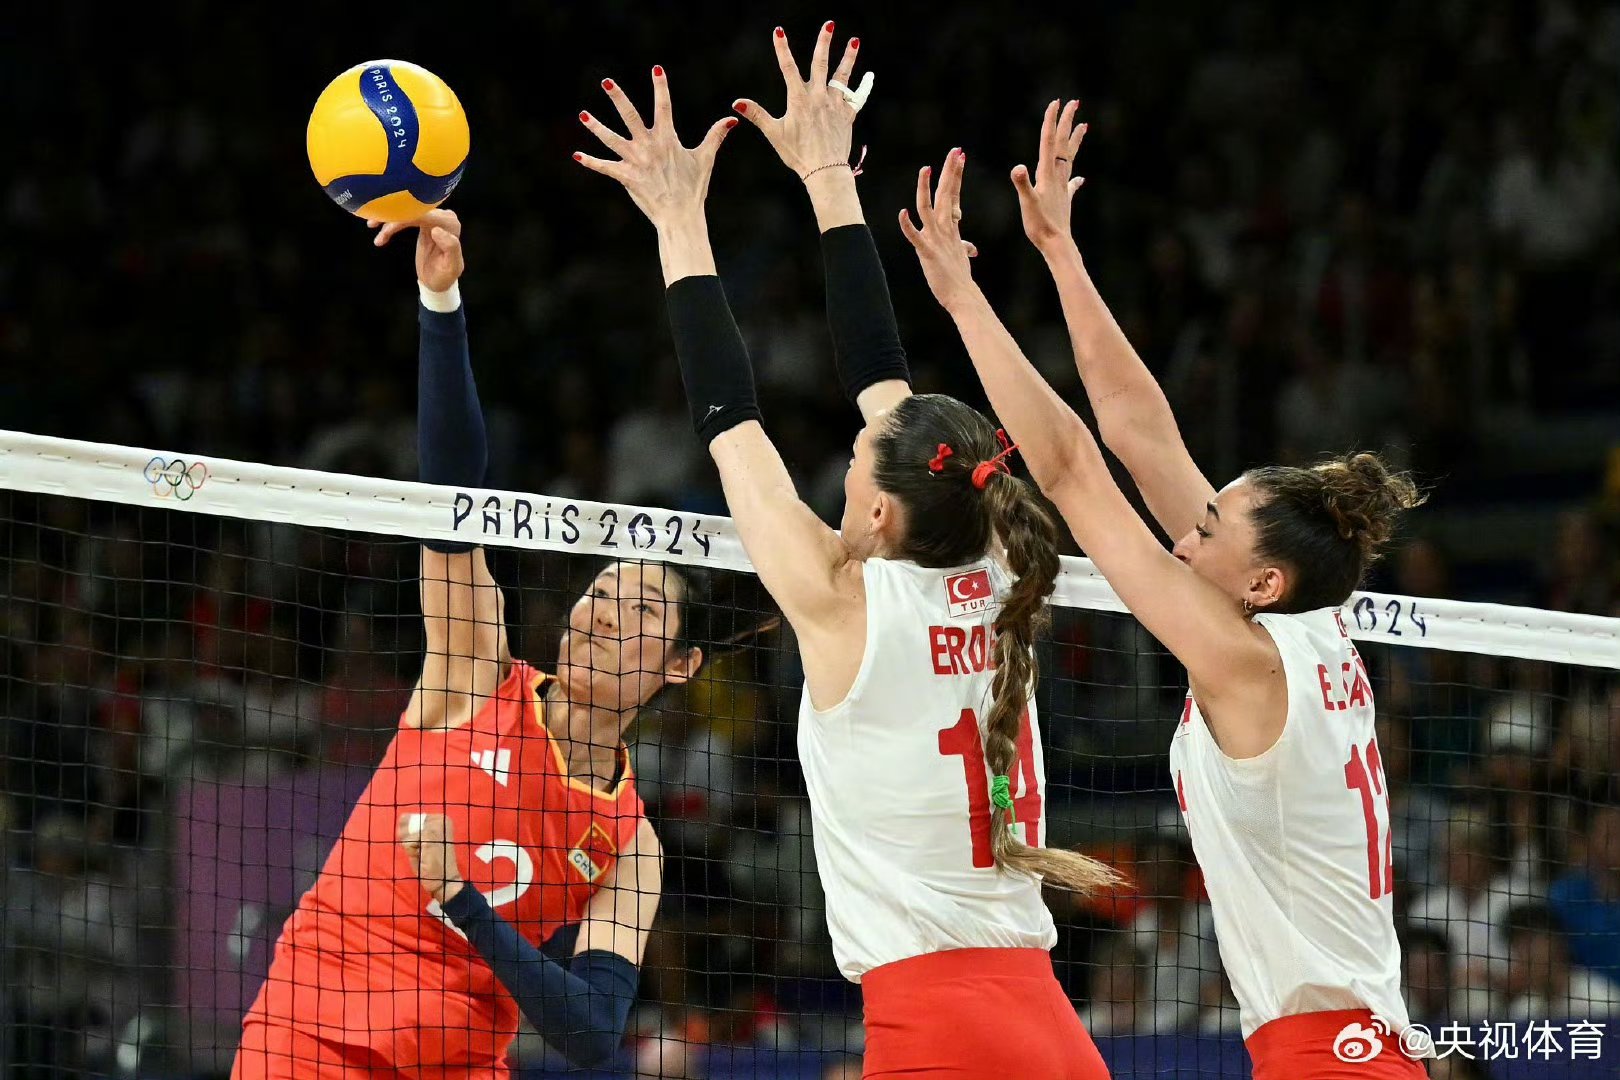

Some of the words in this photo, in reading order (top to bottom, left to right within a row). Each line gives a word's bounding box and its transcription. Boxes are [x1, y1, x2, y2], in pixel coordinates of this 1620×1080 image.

[386, 106, 407, 149] 2024
[599, 508, 710, 557] 2024
[961, 599, 986, 612] TUR
